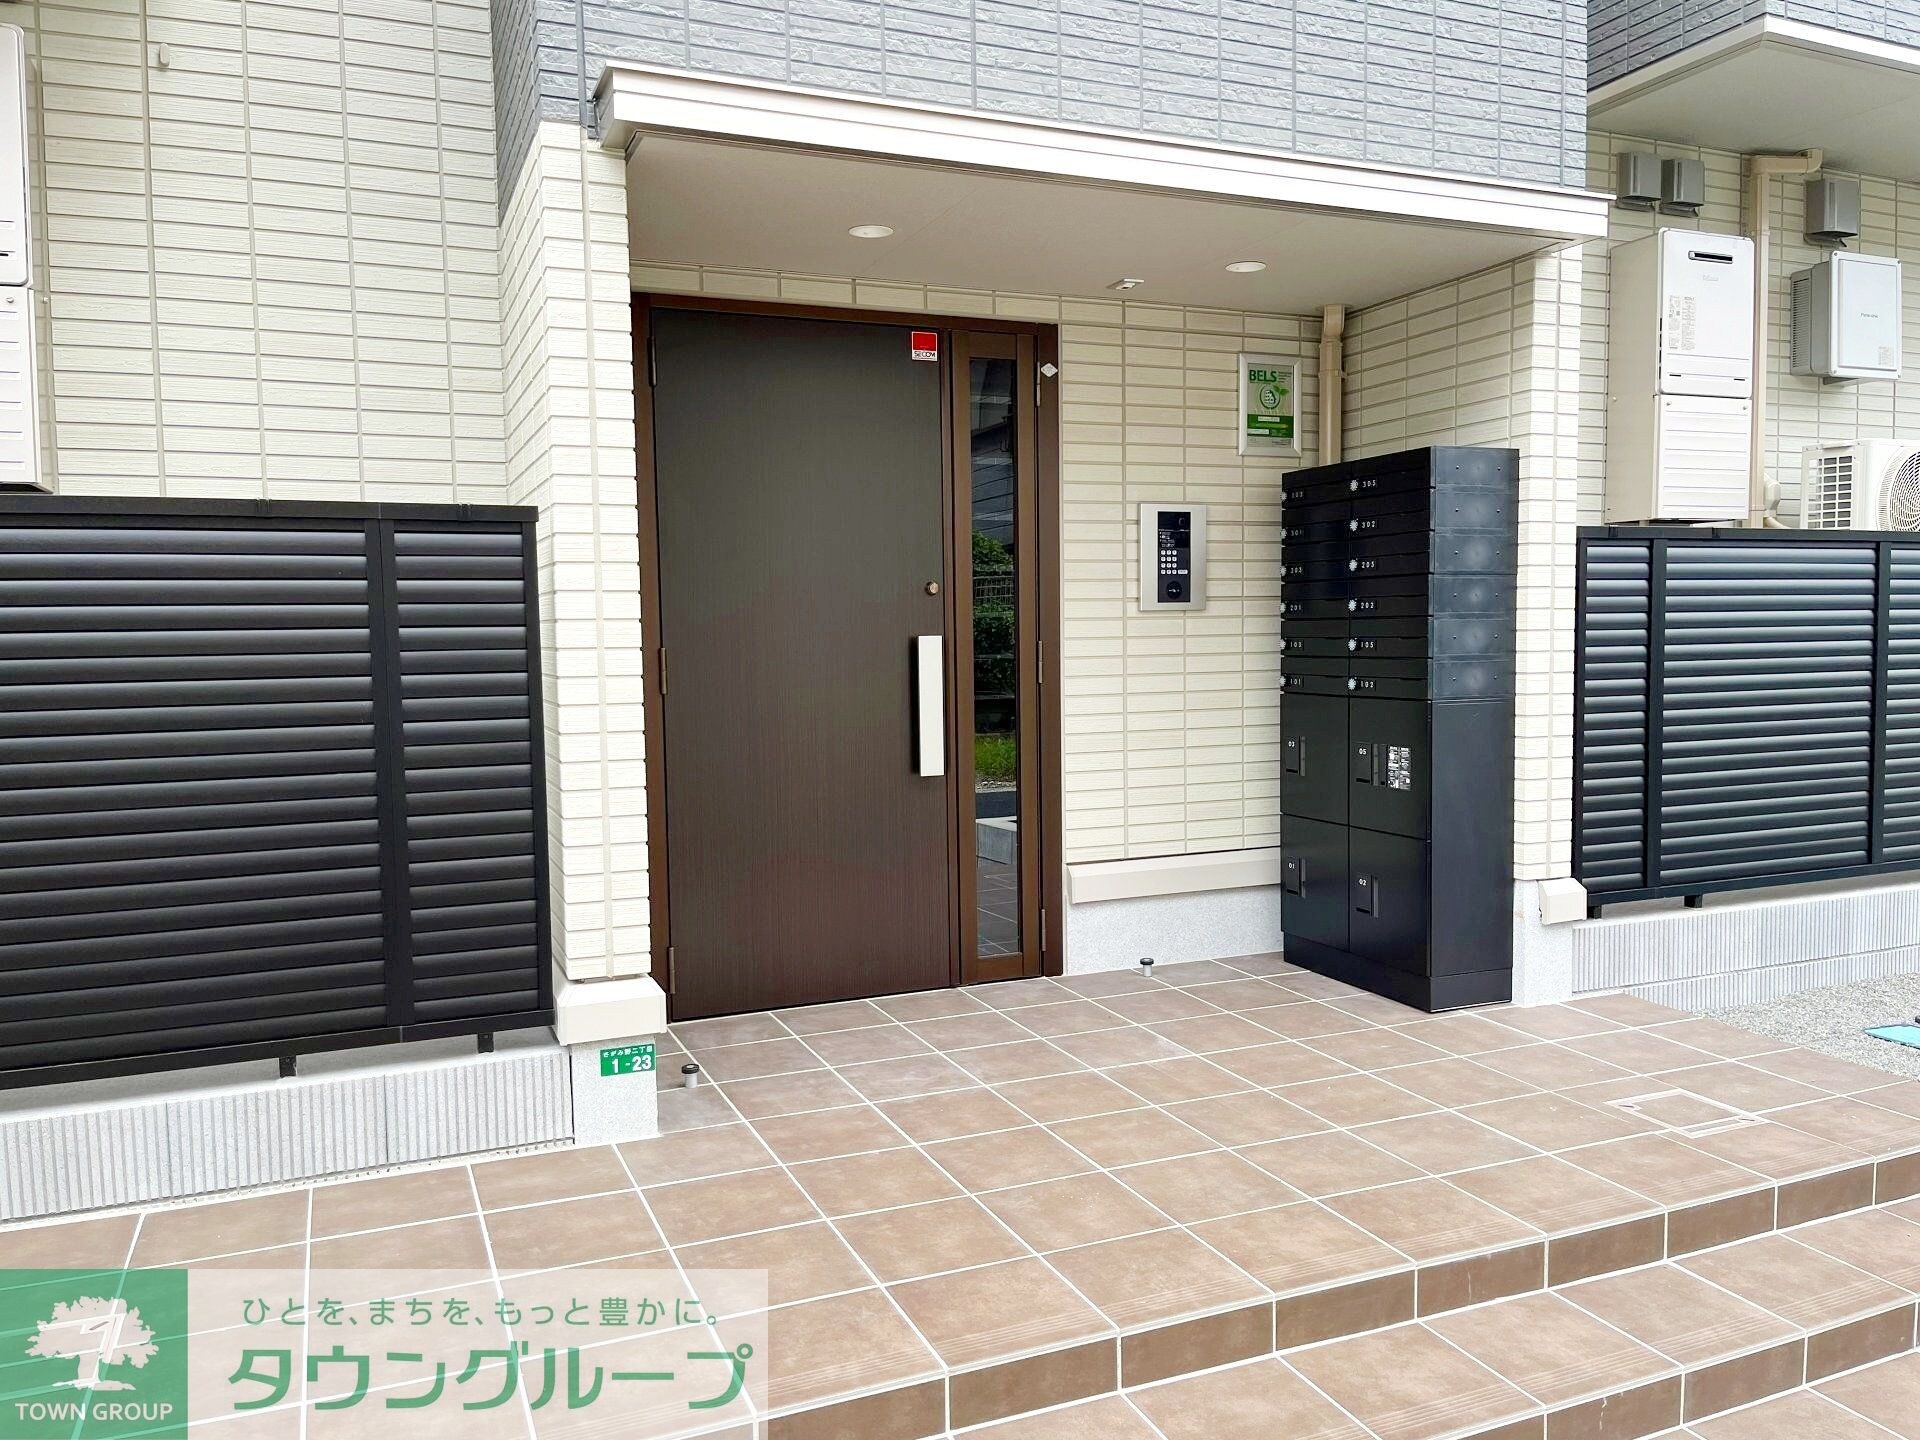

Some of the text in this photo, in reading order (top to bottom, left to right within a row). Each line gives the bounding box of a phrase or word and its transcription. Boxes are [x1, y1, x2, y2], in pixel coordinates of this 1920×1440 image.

[914, 350, 936, 358] SECOM
[1249, 369, 1278, 383] BELS
[1362, 479, 1376, 488] 305
[1361, 520, 1376, 529] 302
[1361, 560, 1375, 569] 205
[1360, 641, 1374, 649] 105
[1358, 878, 1367, 886] 02
